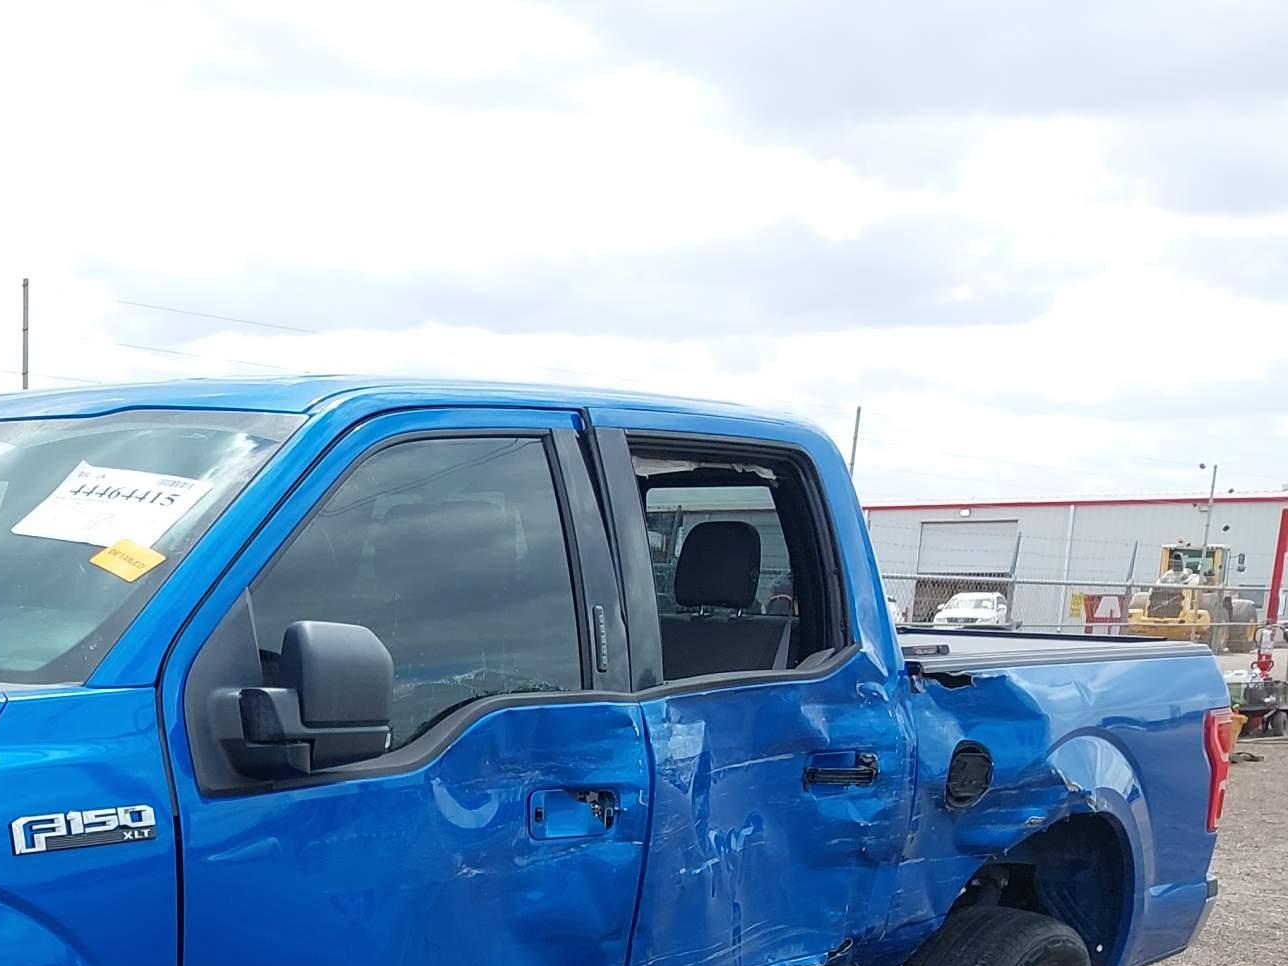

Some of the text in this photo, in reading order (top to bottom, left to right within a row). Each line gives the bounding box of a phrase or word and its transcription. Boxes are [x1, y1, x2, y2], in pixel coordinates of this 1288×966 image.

[69, 484, 181, 507] 44464415
[108, 548, 146, 570] DETAILED
[123, 829, 151, 841] XLT
